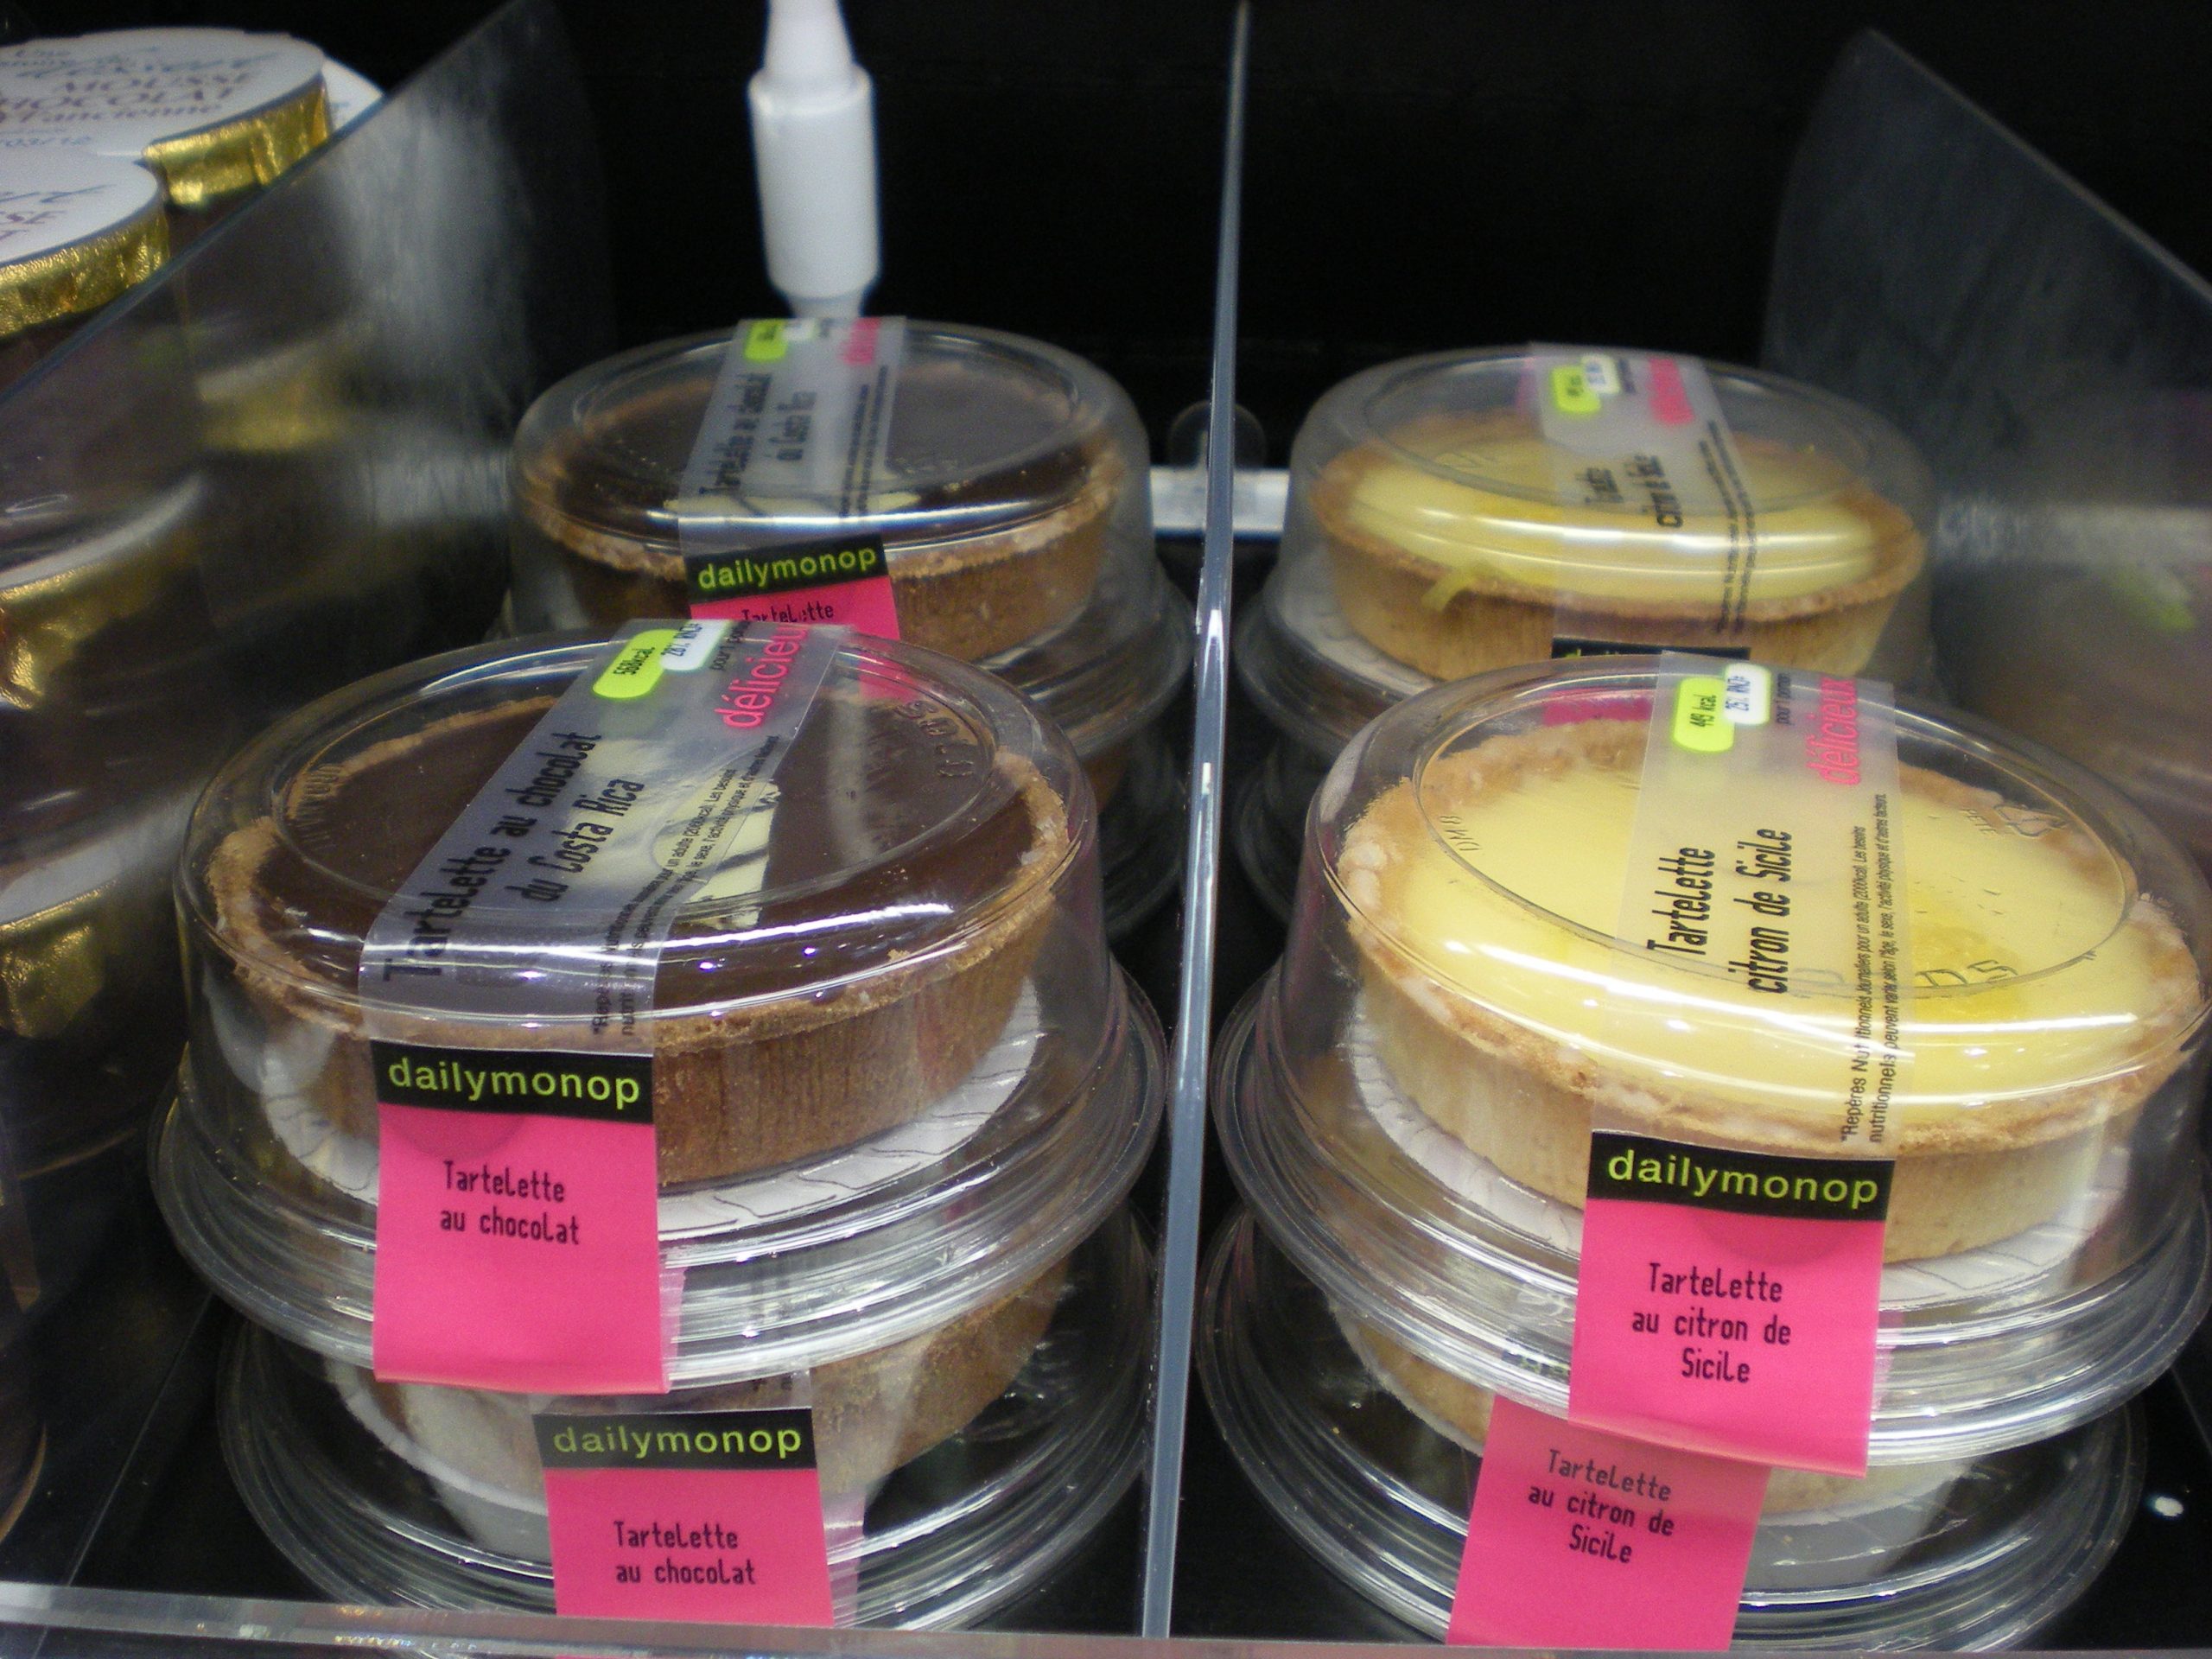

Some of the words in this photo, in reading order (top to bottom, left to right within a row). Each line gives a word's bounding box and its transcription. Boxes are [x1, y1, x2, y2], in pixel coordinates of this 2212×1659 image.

[697, 546, 877, 590] dailymonop
[714, 626, 810, 729] délicieu
[1806, 676, 1861, 785] délicieux
[506, 731, 602, 809] chocolat
[573, 777, 645, 818] Rica
[491, 815, 537, 840] au
[527, 820, 614, 876] Costa
[1734, 827, 1792, 883] Sicile
[1852, 850, 1867, 863] Les
[506, 872, 569, 904] du
[1646, 846, 1716, 957] Tartelette
[1733, 889, 1790, 918] de
[383, 842, 512, 982] Tartelette
[1856, 924, 1871, 934] un
[1728, 925, 1790, 995] citron
[387, 1058, 640, 1111] dailymonop
[1869, 1053, 1897, 1143] nutritionnels
[1883, 1005, 1902, 1050] peuvent
[442, 1160, 566, 1203] Tartelette
[1607, 1149, 1878, 1210] dailymonop
[439, 1208, 467, 1232] au
[479, 1208, 581, 1245] chocolat
[1648, 1262, 1783, 1303] Tartelette
[1631, 1311, 1660, 1335] au
[1674, 1307, 1749, 1343] citron
[1763, 1314, 1792, 1345] de
[1681, 1347, 1751, 1384] Sicile
[553, 1426, 803, 1459] dailymonop
[1548, 1447, 1672, 1503] Tartelette
[1528, 1484, 1554, 1508] au
[1567, 1487, 1635, 1528] citron
[1648, 1506, 1675, 1537] de
[613, 1521, 739, 1550] Tartelette
[1568, 1523, 1633, 1565] Sicile
[615, 1561, 642, 1585] au
[654, 1558, 757, 1586] chocolat
